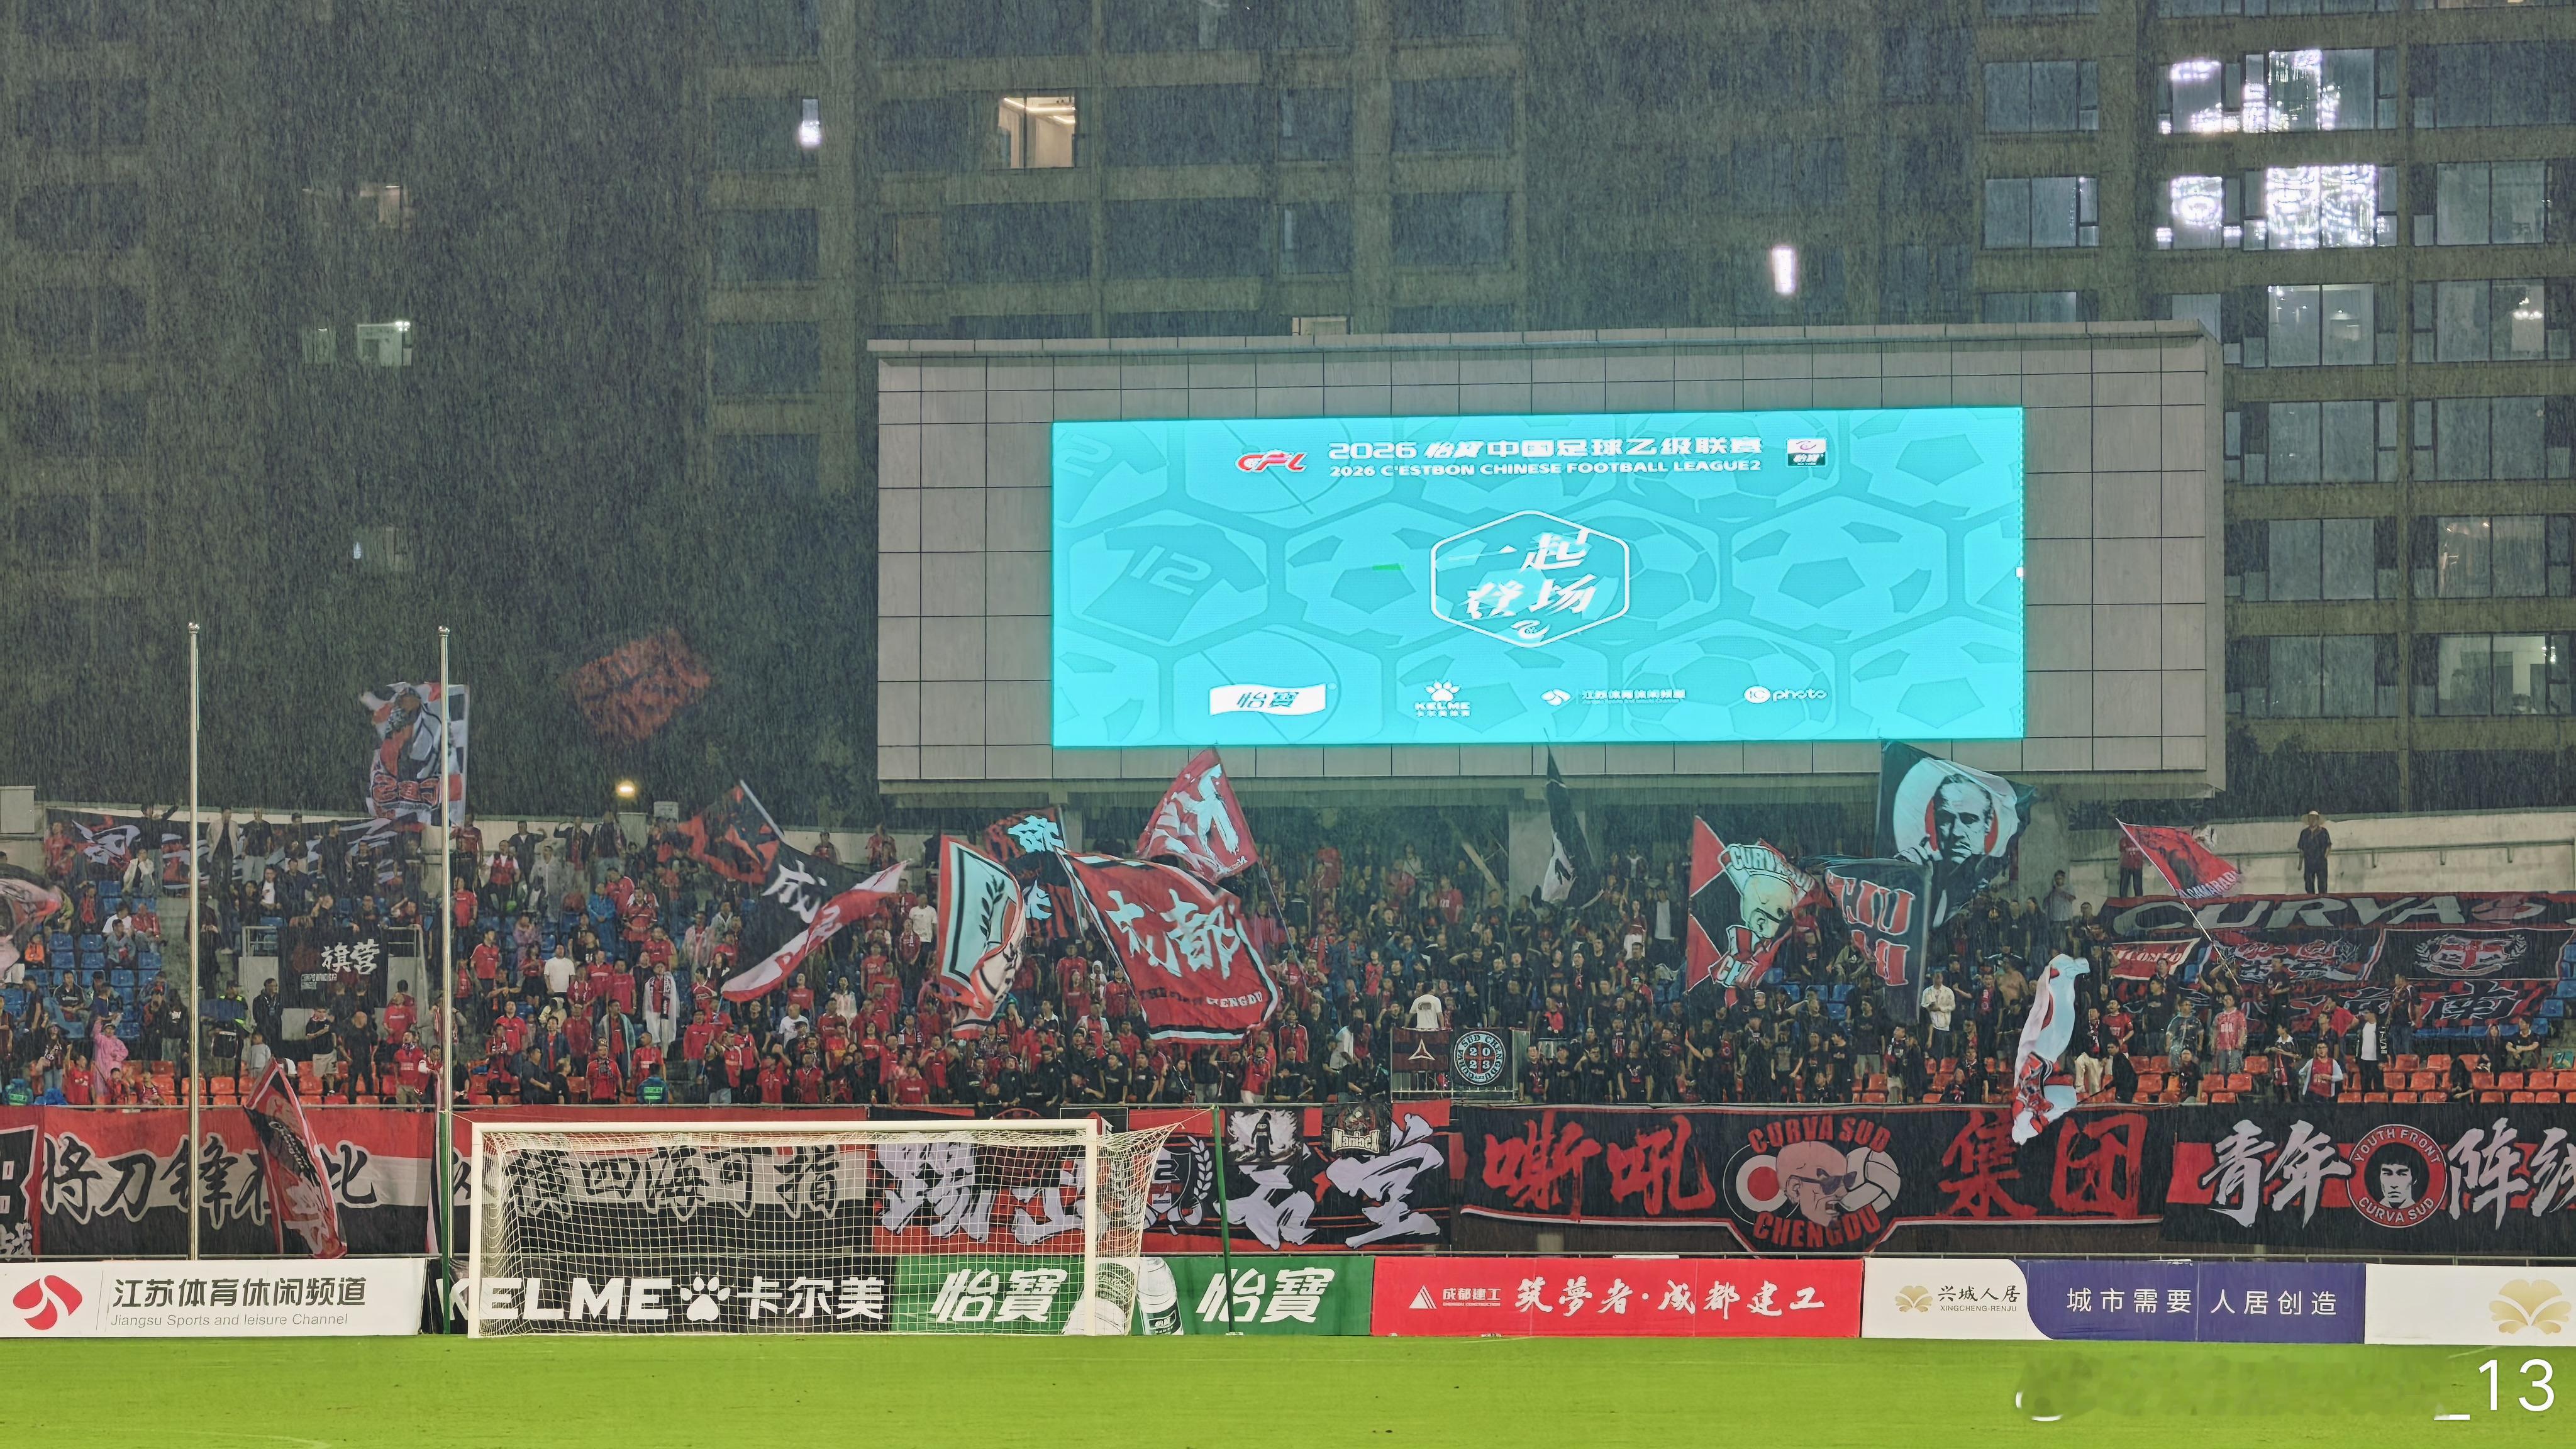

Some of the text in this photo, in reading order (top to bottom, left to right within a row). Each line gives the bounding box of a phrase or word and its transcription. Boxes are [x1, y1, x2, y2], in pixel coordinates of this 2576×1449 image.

[1328, 441, 1417, 460] 2026
[1329, 465, 1375, 478] 2026
[1480, 462, 1562, 475] CHINESE
[1566, 461, 1668, 474] FOOTBALL
[2113, 896, 2465, 936] CURVA
[1461, 1035, 1481, 1048] SUD
[1484, 1036, 1502, 1079] CHENGDU
[1748, 1116, 1891, 1154] CURVA SUD
[2355, 1128, 2441, 1164] YOUTH FRONT
[2201, 1118, 2353, 1230] 青年
[1752, 1202, 1880, 1248] CHENGDU
[2358, 1195, 2436, 1225] CURVA SUD
[113, 1277, 366, 1307] 江苏体育休闲频道
[435, 1276, 672, 1321] KELME
[737, 1275, 885, 1320] 卡尔美
[1443, 1288, 1501, 1301] 成都建工
[1936, 1285, 2021, 1303] 兴城人居
[2067, 1287, 2337, 1316] 城市需要 人居创造
[111, 1313, 348, 1328] Jiangsu Sports and leisure Channel
